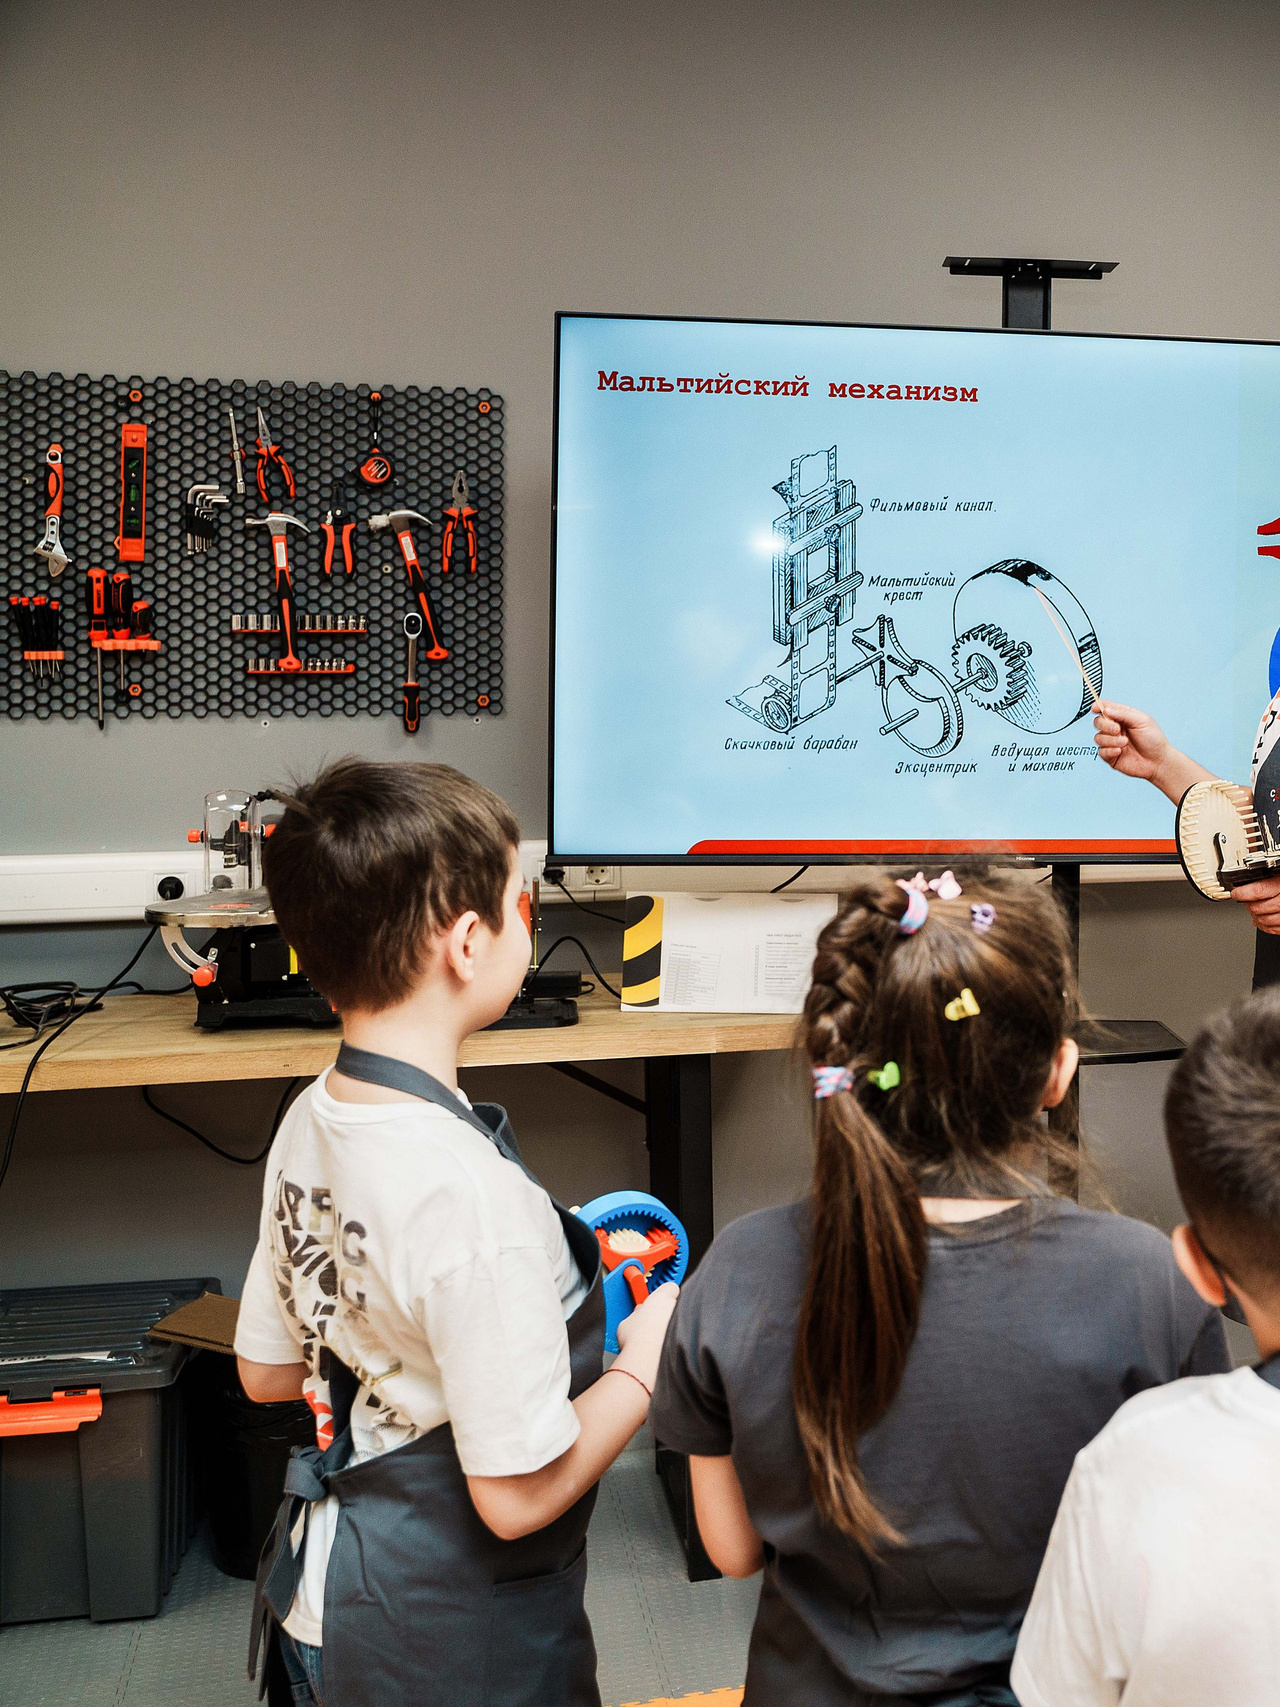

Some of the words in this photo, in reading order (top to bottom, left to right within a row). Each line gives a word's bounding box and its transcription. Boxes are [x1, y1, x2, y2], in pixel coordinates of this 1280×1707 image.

[597, 370, 810, 397] Мальтийский
[827, 380, 979, 403] механизм
[869, 495, 949, 513] Фильмовый
[867, 571, 956, 588] Мальтийский
[883, 591, 923, 606] крест
[724, 735, 796, 751] Скачковый
[803, 734, 858, 754] барабан
[991, 742, 1050, 761] Ведущая
[895, 761, 978, 778] Эксцентрик
[1008, 763, 1017, 772] и
[1021, 760, 1076, 772] маховик
